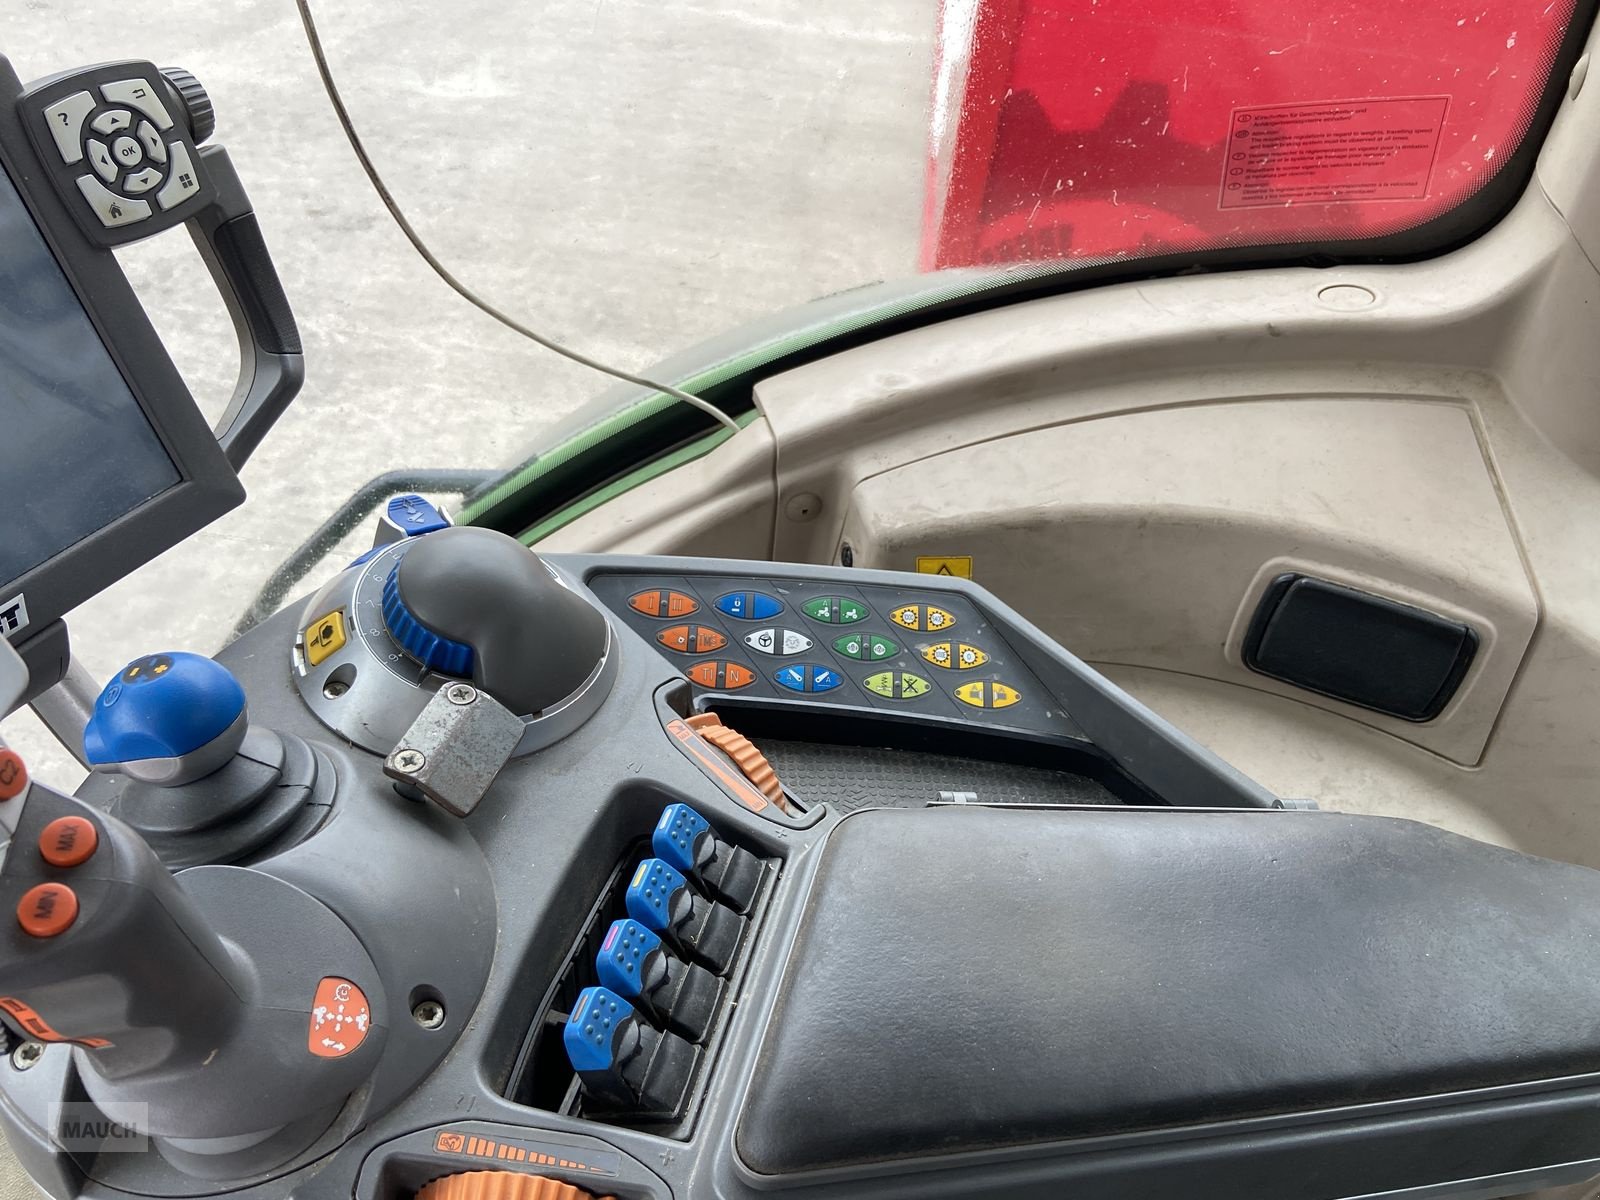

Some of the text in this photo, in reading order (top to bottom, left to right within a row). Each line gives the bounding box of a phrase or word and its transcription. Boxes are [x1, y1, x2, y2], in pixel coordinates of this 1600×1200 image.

[121, 145, 137, 158] OK
[369, 628, 381, 638] 8
[702, 668, 714, 681] TI
[730, 670, 739, 682] N
[0, 759, 20, 785] C2
[55, 824, 80, 852] MAX
[33, 890, 59, 920] MIN
